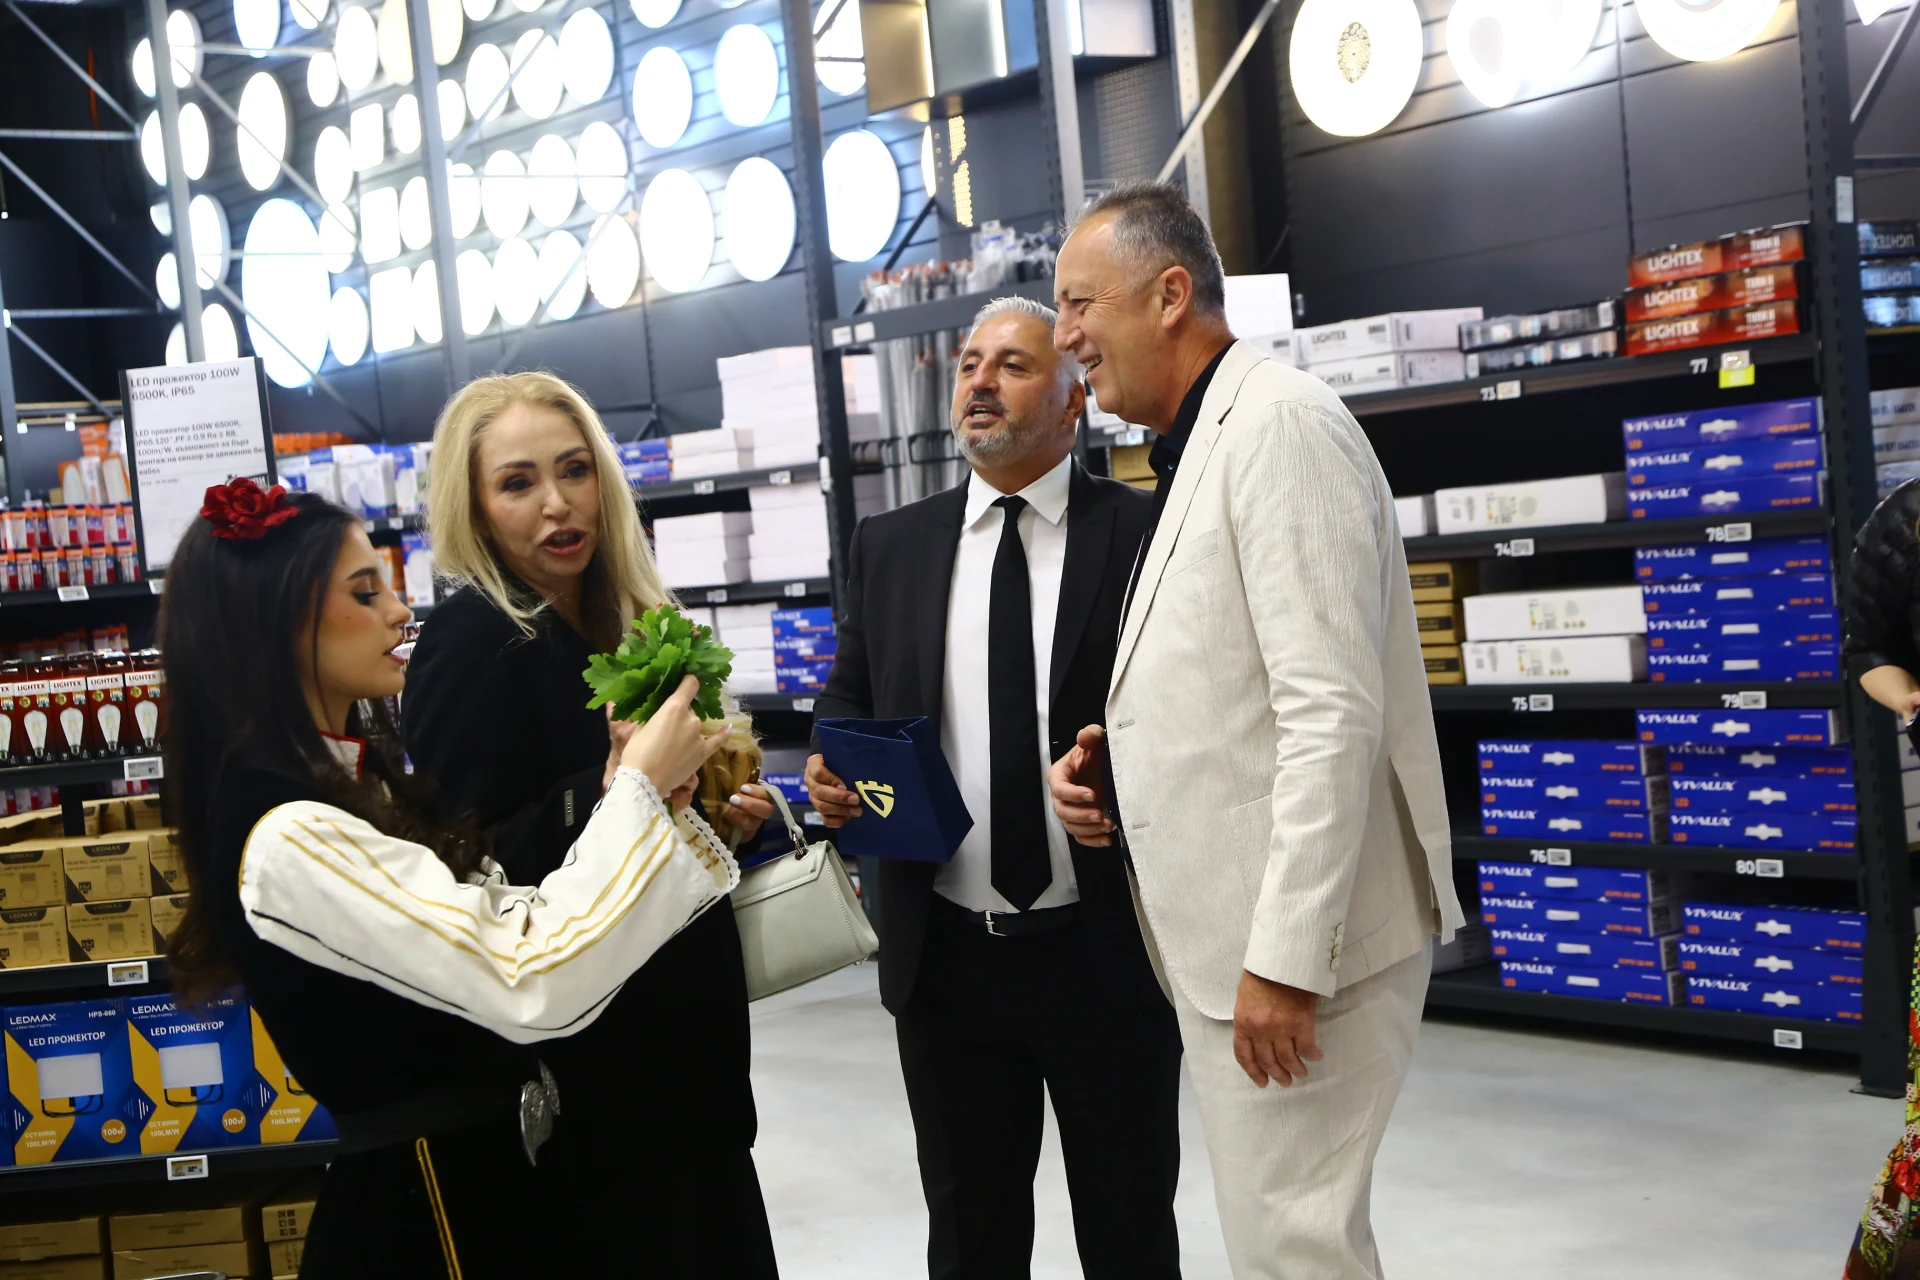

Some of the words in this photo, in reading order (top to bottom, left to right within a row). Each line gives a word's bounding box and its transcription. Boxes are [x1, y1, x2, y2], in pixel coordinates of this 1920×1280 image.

[1647, 248, 1703, 272] LIGHTEX
[1644, 286, 1698, 307] LIGHTEX
[1645, 319, 1700, 341] LIGHTEX
[1311, 329, 1347, 345] LIGHTEX
[1689, 358, 1709, 374] 77
[130, 377, 150, 388] LED
[152, 373, 207, 386] прожектор
[210, 367, 240, 379] 100W
[171, 385, 195, 397] IP65
[1480, 386, 1496, 401] 73
[151, 426, 190, 437] прожектор
[192, 423, 213, 431] 100W
[1627, 415, 1690, 433] VIVALUX
[1630, 451, 1693, 467] VIVALUX
[1629, 486, 1692, 502] VIVALUX
[1705, 526, 1725, 542] 78
[1636, 546, 1698, 559] VIVALUX
[1643, 582, 1705, 595] VIVALUX
[1648, 618, 1711, 631] VIVALUX
[1649, 654, 1711, 665] VIVALUX
[90, 677, 119, 686] LIGHTEX
[129, 674, 157, 682] LIGHTEX
[17, 683, 45, 692] LIGHTEX
[53, 681, 82, 689] LIGHTEX
[1511, 697, 1528, 711] 75
[1721, 694, 1740, 708] 79
[1638, 713, 1701, 725] VIVALUX
[1479, 743, 1533, 753] VIVALUX
[1481, 777, 1537, 788] VIVALUX
[1672, 780, 1737, 792] VIVALUX
[1482, 809, 1538, 820] VIVALUX
[1670, 815, 1734, 827] VIVALUX
[92, 844, 121, 853] LEDMAX
[1530, 849, 1547, 863] 76
[1479, 865, 1534, 877] VIVALUX
[1736, 860, 1755, 875] 80
[1481, 897, 1536, 909] VIVALUX
[9, 911, 38, 919] LEDMAX
[1684, 907, 1745, 921] VIVALUX
[1491, 930, 1547, 943] VIVALUX
[1679, 943, 1744, 957] VIVALUX
[1501, 961, 1556, 975] VIVALUX
[1689, 977, 1752, 992] VIVALUX
[132, 1003, 177, 1015] LEDMAX
[10, 1013, 56, 1025] LEDMAX
[150, 1027, 167, 1036] LED
[169, 1021, 224, 1034] ПРОЖЕКТОР
[29, 1038, 45, 1047] LED
[48, 1031, 106, 1045] ПРОЖЕКТОР
[271, 1117, 301, 1125] 100LM/W
[150, 1128, 179, 1137] 100LM/W
[26, 1139, 57, 1148] 100LM/W
